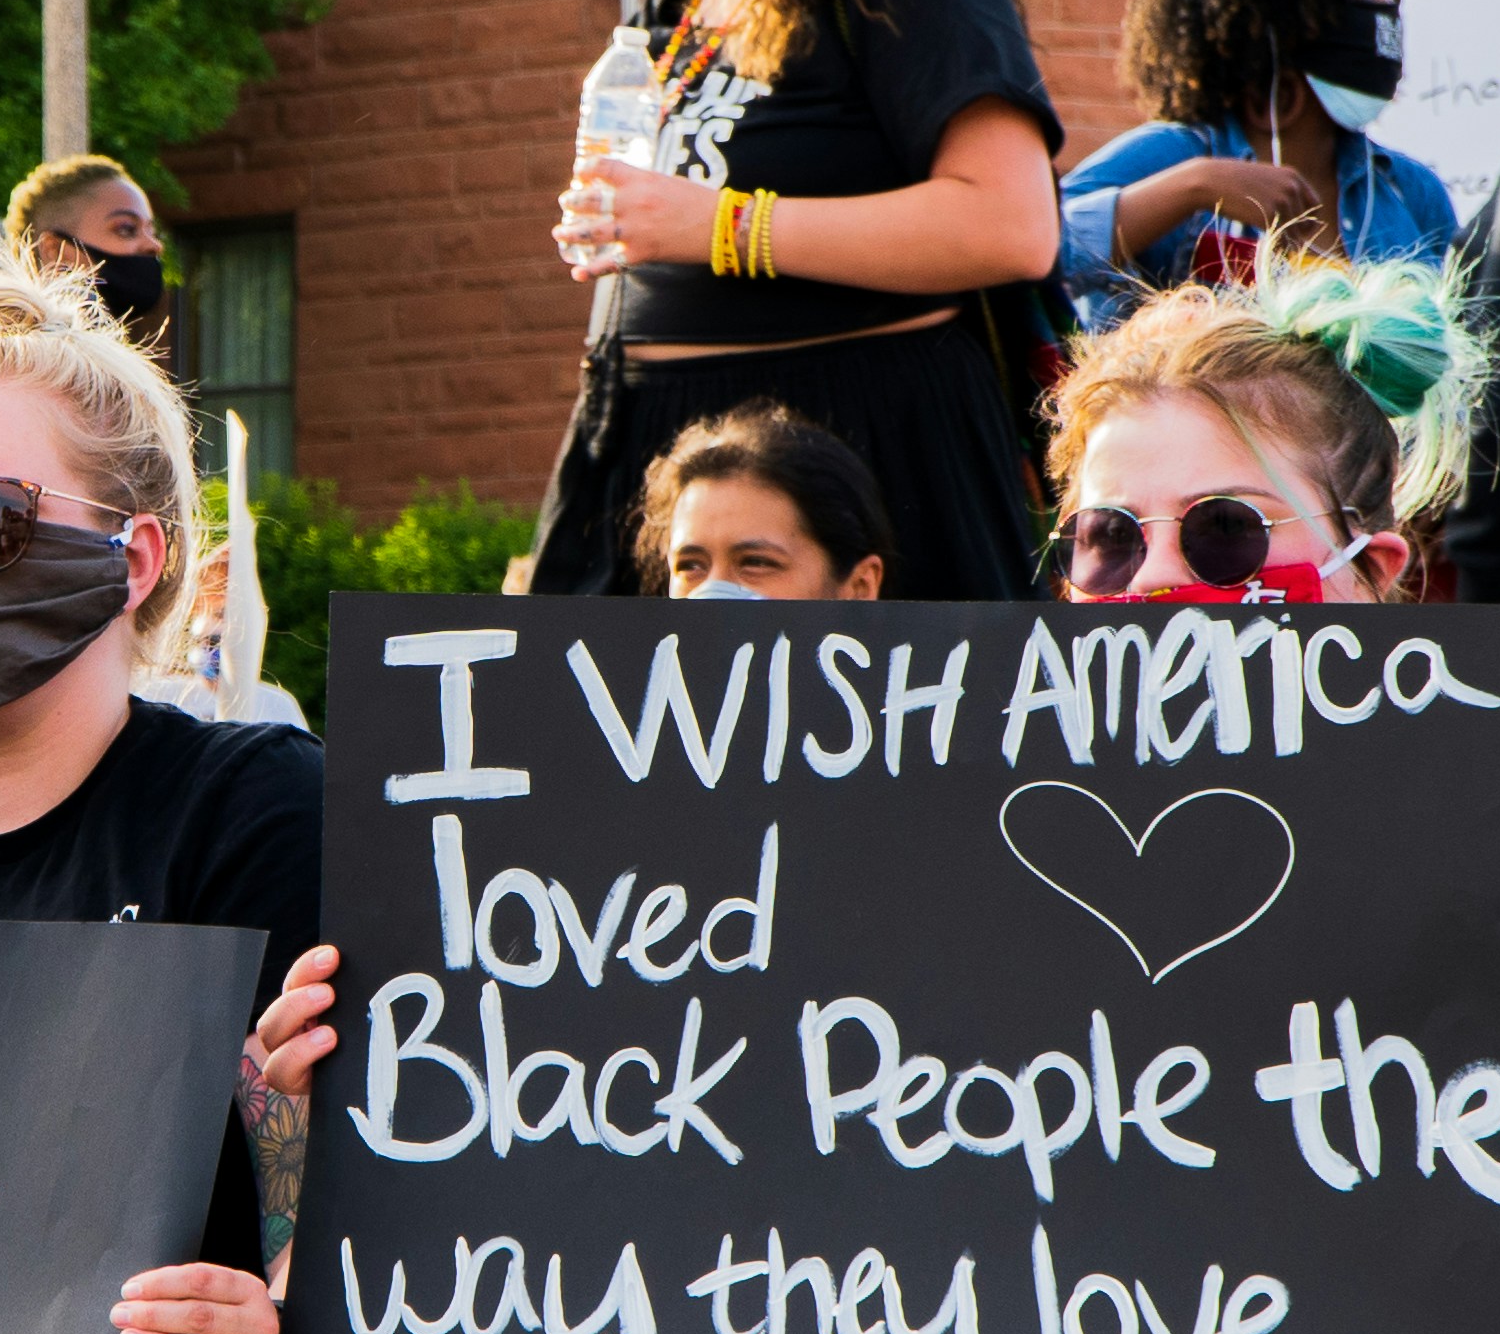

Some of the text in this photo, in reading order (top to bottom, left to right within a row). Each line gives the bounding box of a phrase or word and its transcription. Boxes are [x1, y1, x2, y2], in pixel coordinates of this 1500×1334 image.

[383, 628, 531, 804] I
[565, 630, 970, 789] WISH
[431, 812, 780, 987] loved
[346, 972, 748, 1165] Black
[799, 996, 1216, 1203] People
